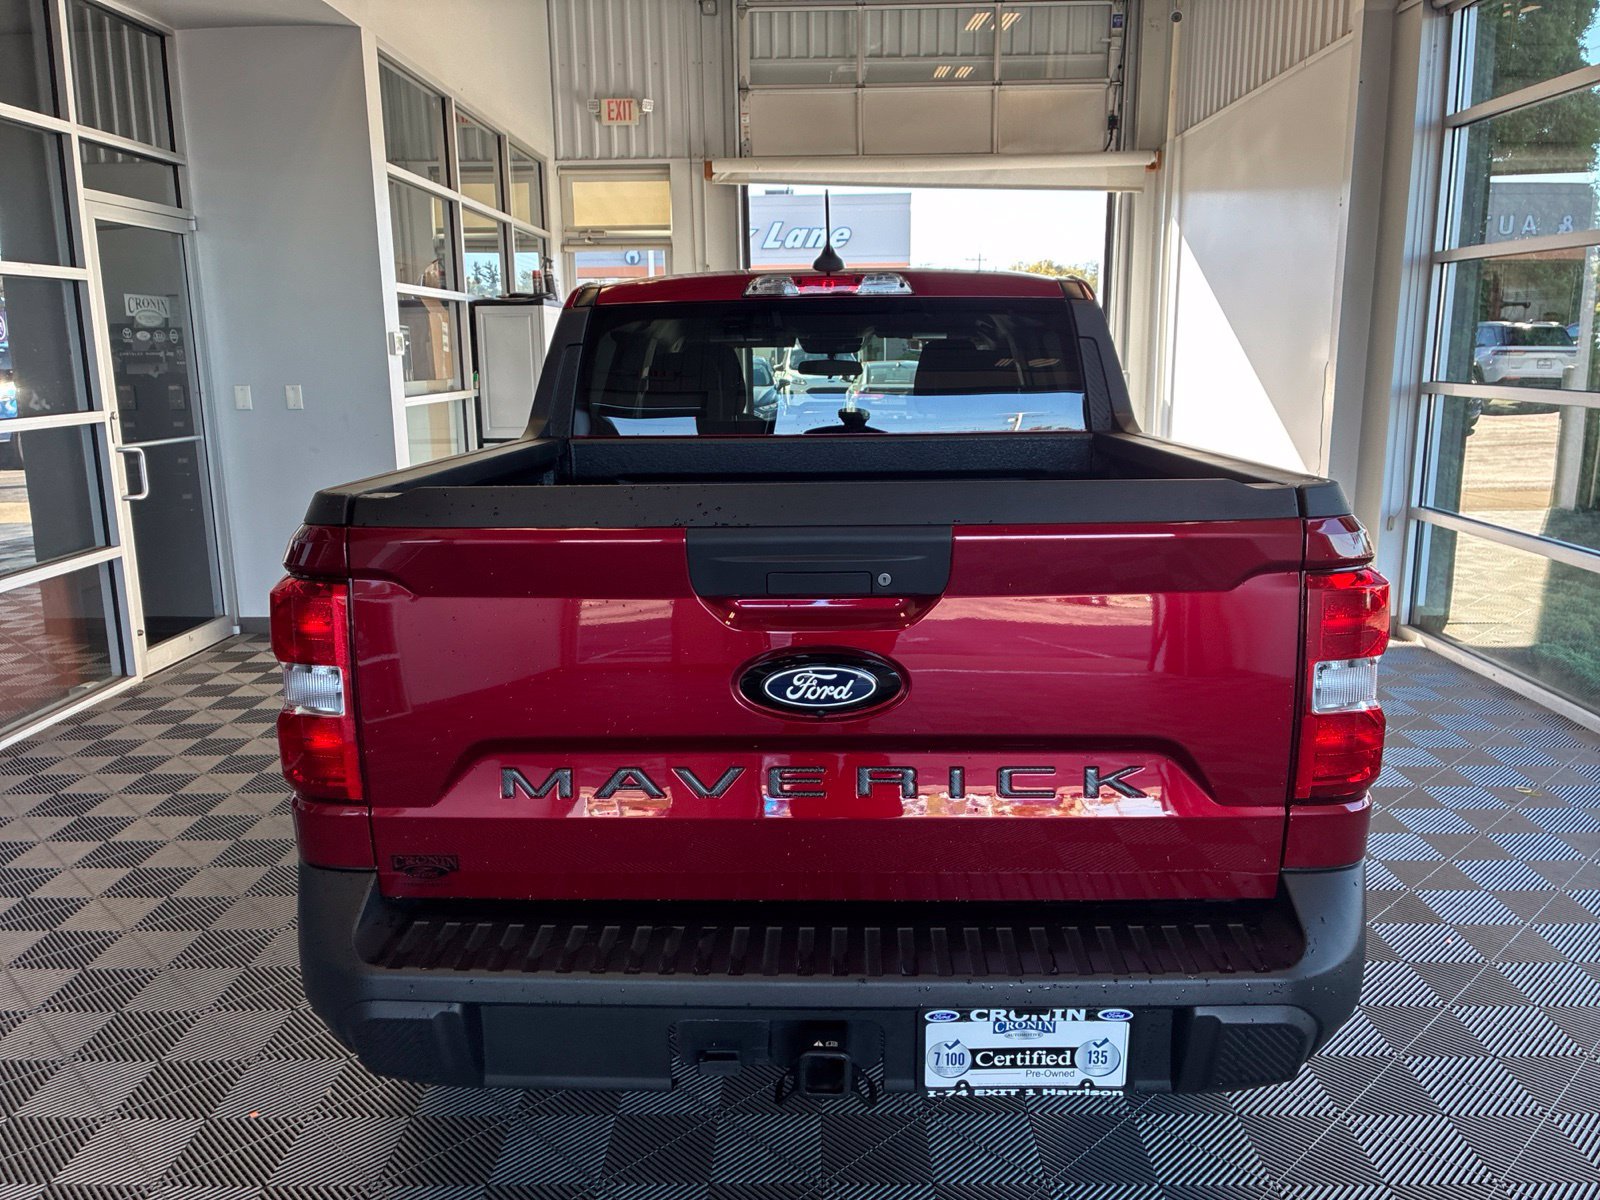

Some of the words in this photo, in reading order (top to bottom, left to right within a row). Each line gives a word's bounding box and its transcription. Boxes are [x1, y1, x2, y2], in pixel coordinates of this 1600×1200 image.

[607, 100, 633, 121] EXIT
[761, 221, 852, 249] Lane
[128, 296, 168, 316] CRONIN
[786, 672, 854, 700] Ford
[501, 767, 1147, 799] MAVERICK
[994, 1021, 1054, 1032] CRONIN
[975, 1051, 1071, 1067] Certified
[1087, 1050, 1108, 1065] 135
[1025, 1070, 1075, 1078] Pre-Owned
[927, 1090, 969, 1098] I-74
[1042, 1088, 1124, 1097] Harrison
